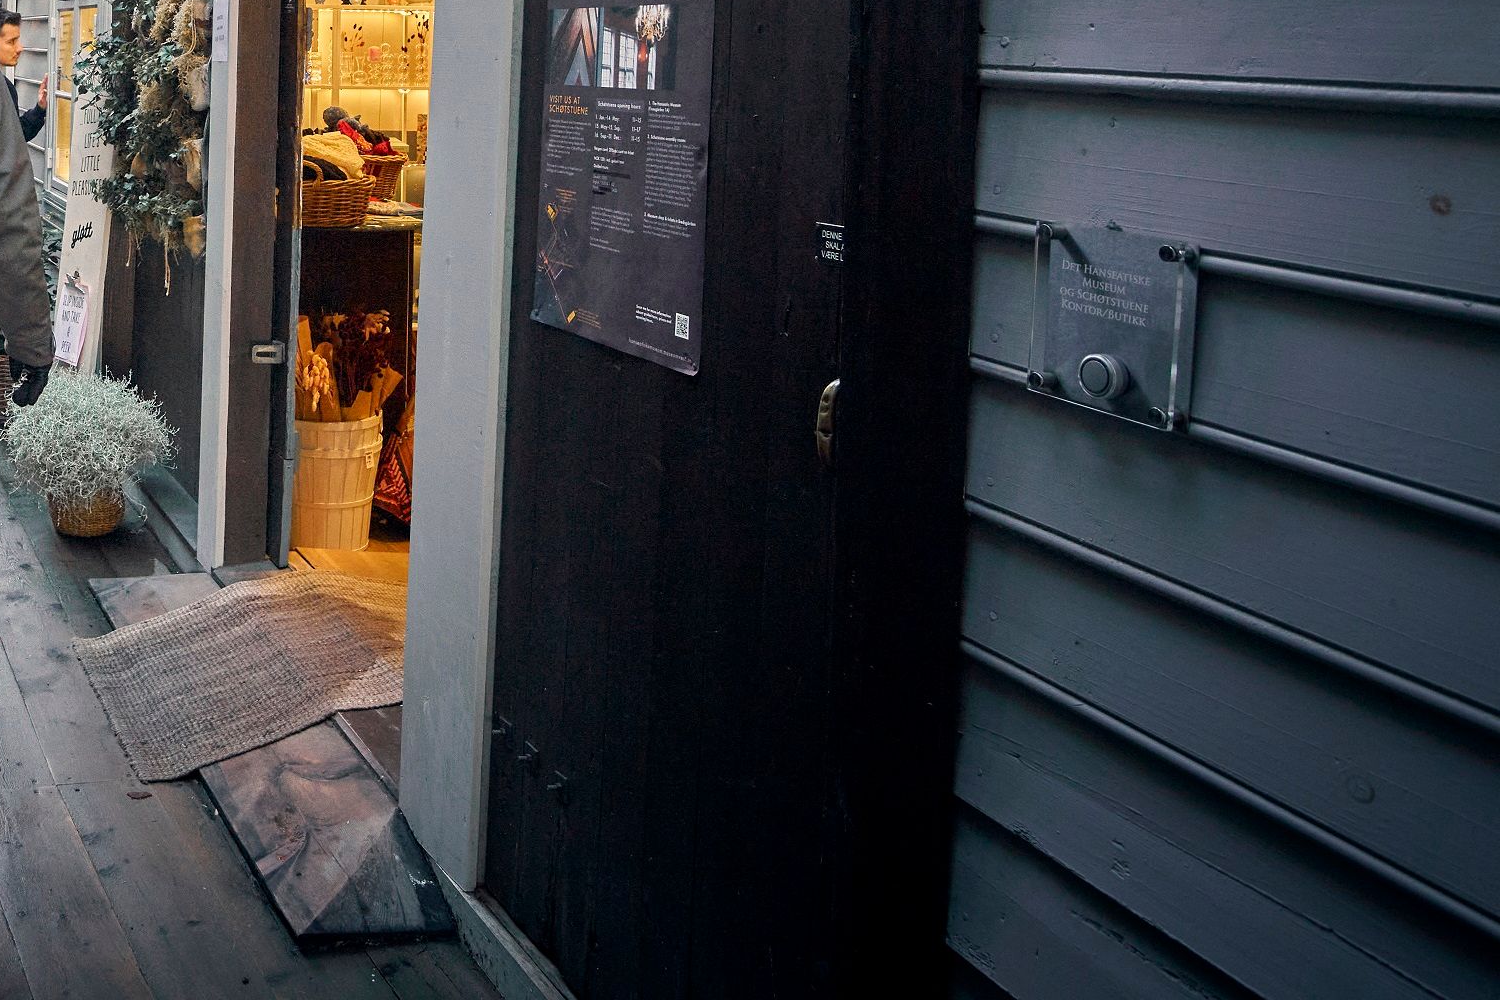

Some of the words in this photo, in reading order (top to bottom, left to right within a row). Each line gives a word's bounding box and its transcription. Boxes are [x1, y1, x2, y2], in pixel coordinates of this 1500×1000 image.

[549, 94, 562, 104] VISIT
[564, 96, 571, 104] US
[573, 96, 580, 105] AT
[549, 104, 588, 116] SCHØTSTUENE
[81, 154, 101, 173] LITTLE
[71, 221, 94, 249] gløtt
[821, 229, 843, 241] DENNE
[825, 240, 841, 251] SKAL
[821, 249, 839, 261] VÆRE
[1062, 258, 1081, 272] DET
[1084, 264, 1151, 286] HANSEATISKE
[1082, 277, 1126, 295] MUSEUM
[1077, 288, 1149, 314] SCHØTSTUENE
[1061, 298, 1147, 327] KONTOR/BUTIKK
